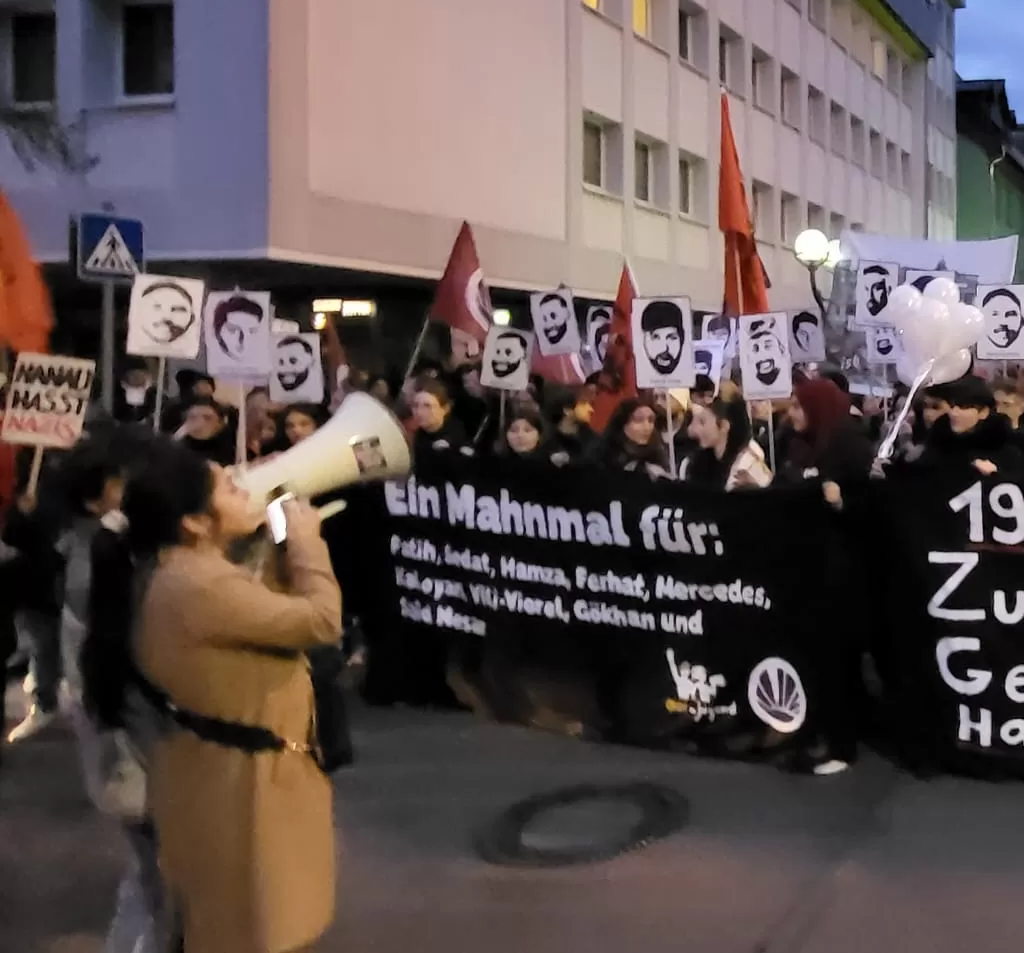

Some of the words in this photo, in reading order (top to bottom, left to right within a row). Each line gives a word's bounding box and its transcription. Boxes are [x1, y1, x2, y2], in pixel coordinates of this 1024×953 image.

[384, 474, 441, 520] Ein
[445, 481, 630, 548] Mahnmal
[640, 506, 725, 556] für:
[655, 574, 772, 610] Mercedes,
[660, 609, 704, 636] und
